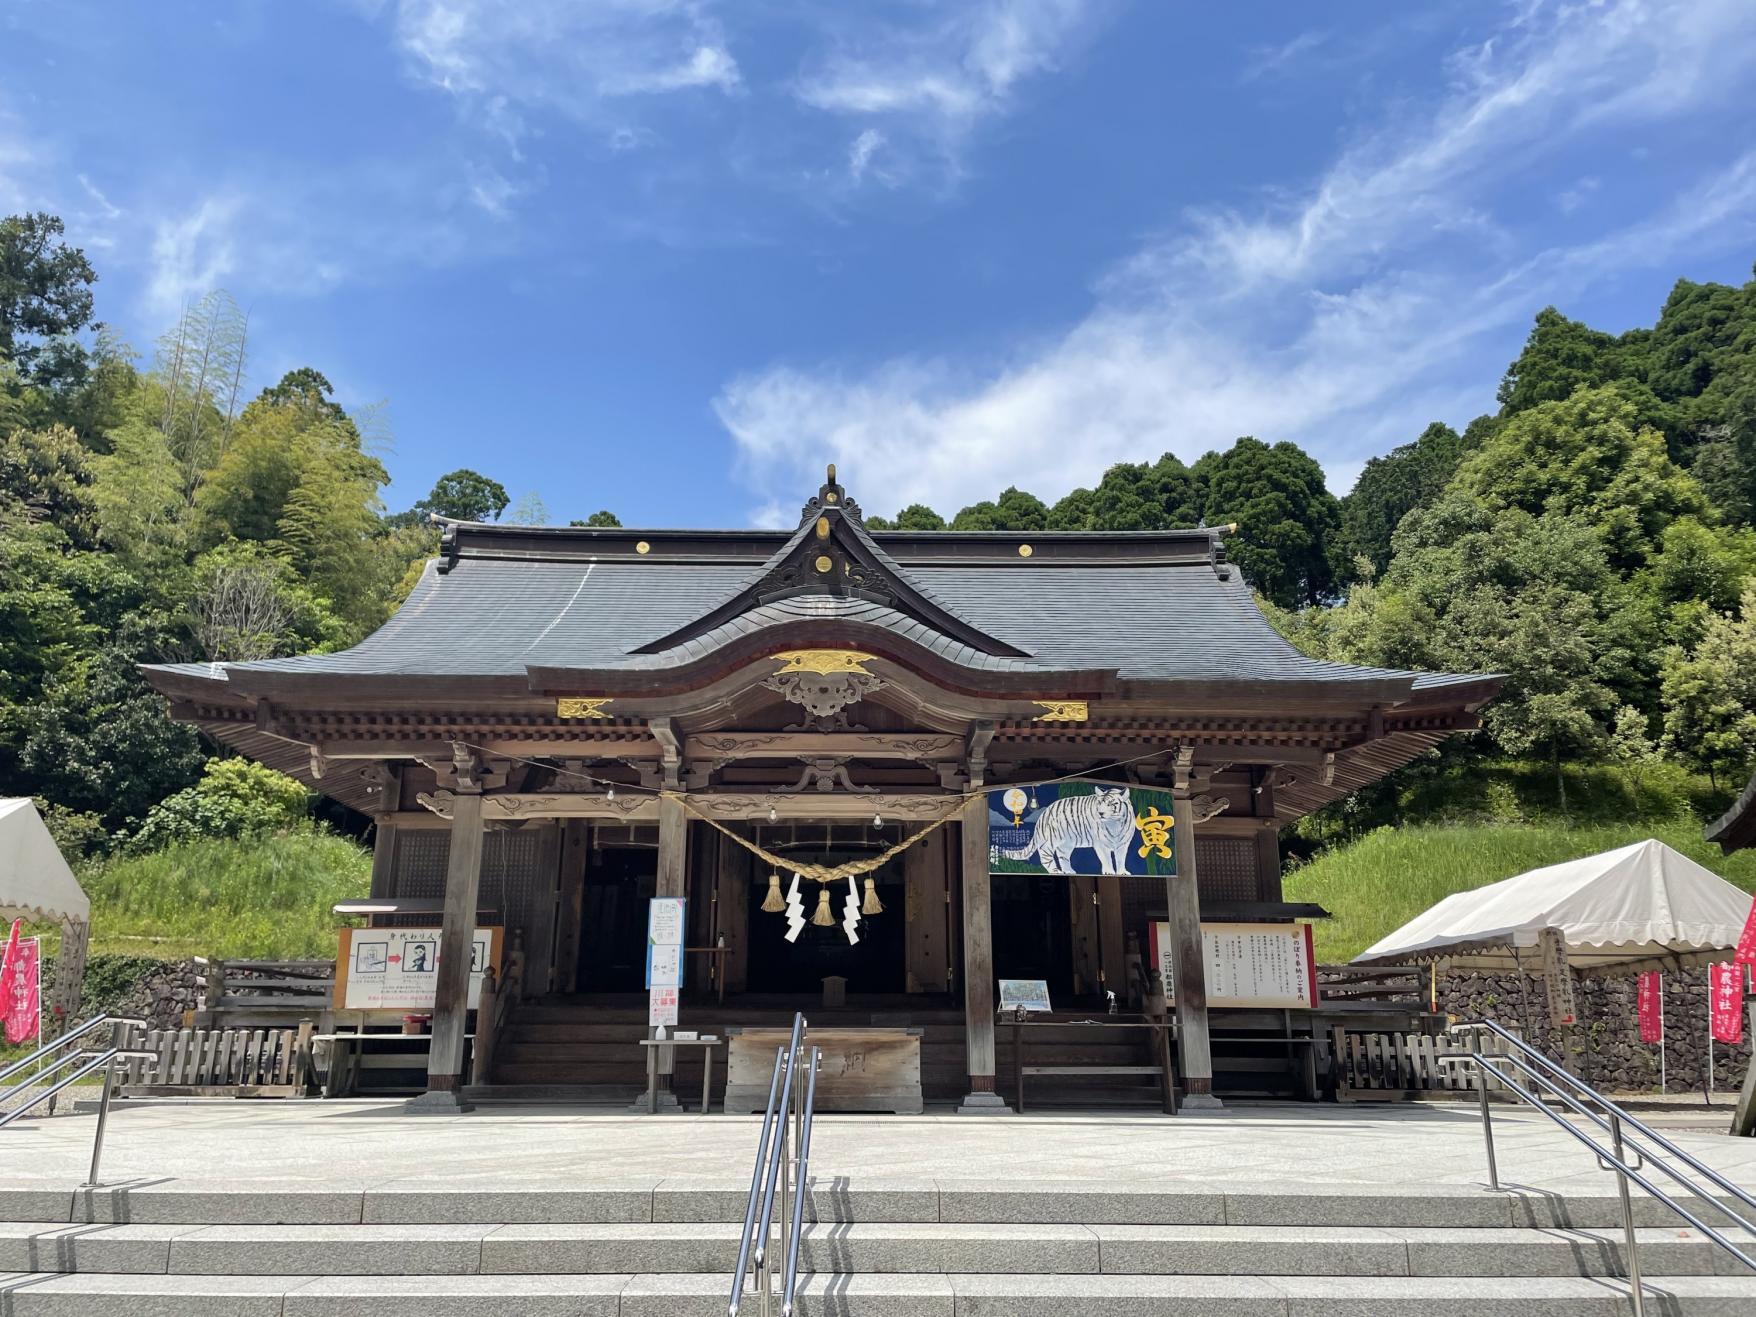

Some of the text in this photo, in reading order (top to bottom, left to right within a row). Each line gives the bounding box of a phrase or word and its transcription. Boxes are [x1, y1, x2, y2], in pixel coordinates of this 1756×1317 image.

[1010, 789, 1024, 829] 令和四年
[1135, 806, 1175, 859] 寅
[1293, 940, 1304, 1001] のぼり奉納のご案内
